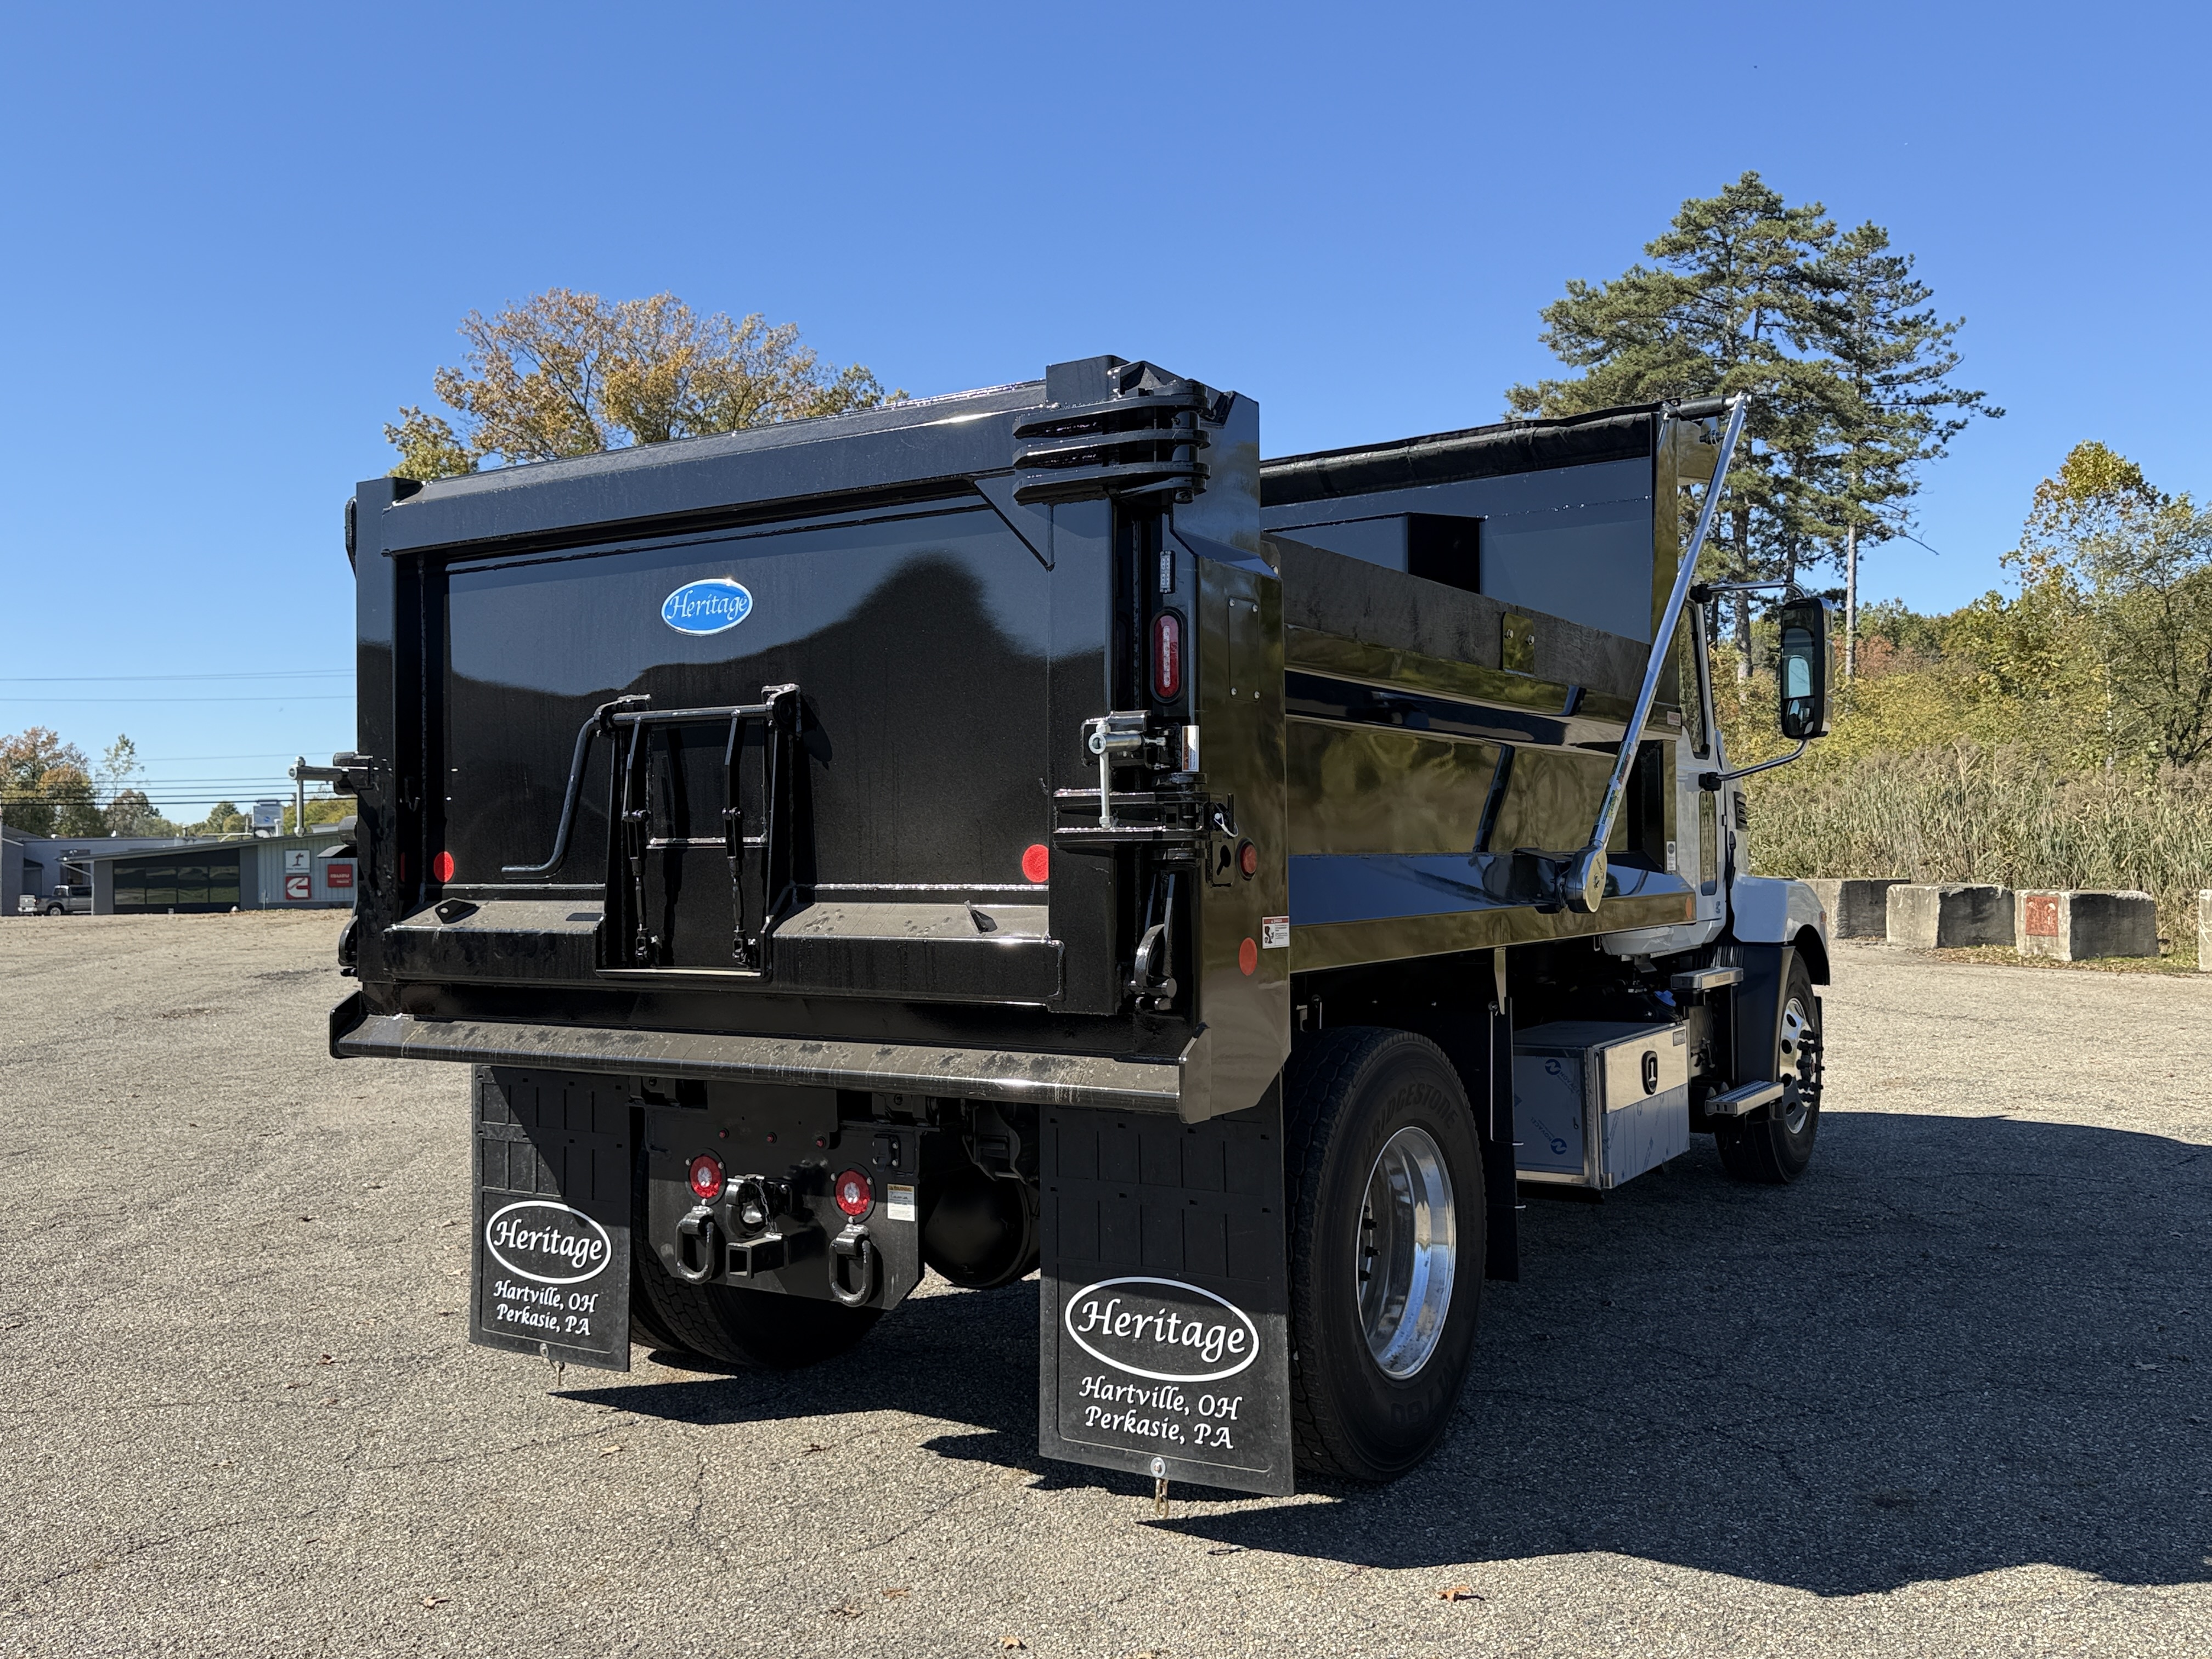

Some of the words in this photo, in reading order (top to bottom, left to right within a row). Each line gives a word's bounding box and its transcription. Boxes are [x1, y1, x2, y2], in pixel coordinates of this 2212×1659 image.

[666, 590, 748, 621] Heritage
[494, 1219, 602, 1268] Heritage
[493, 1279, 564, 1310] Hartville,
[568, 1293, 599, 1313] OH
[496, 1304, 561, 1333] Perkasie,
[565, 1316, 591, 1336] PA
[1077, 1299, 1245, 1363] Heritage
[1079, 1376, 1190, 1416] Hartville,
[1198, 1394, 1243, 1420] OH
[1085, 1406, 1185, 1444] Perkasie,
[1194, 1423, 1234, 1449] PA
